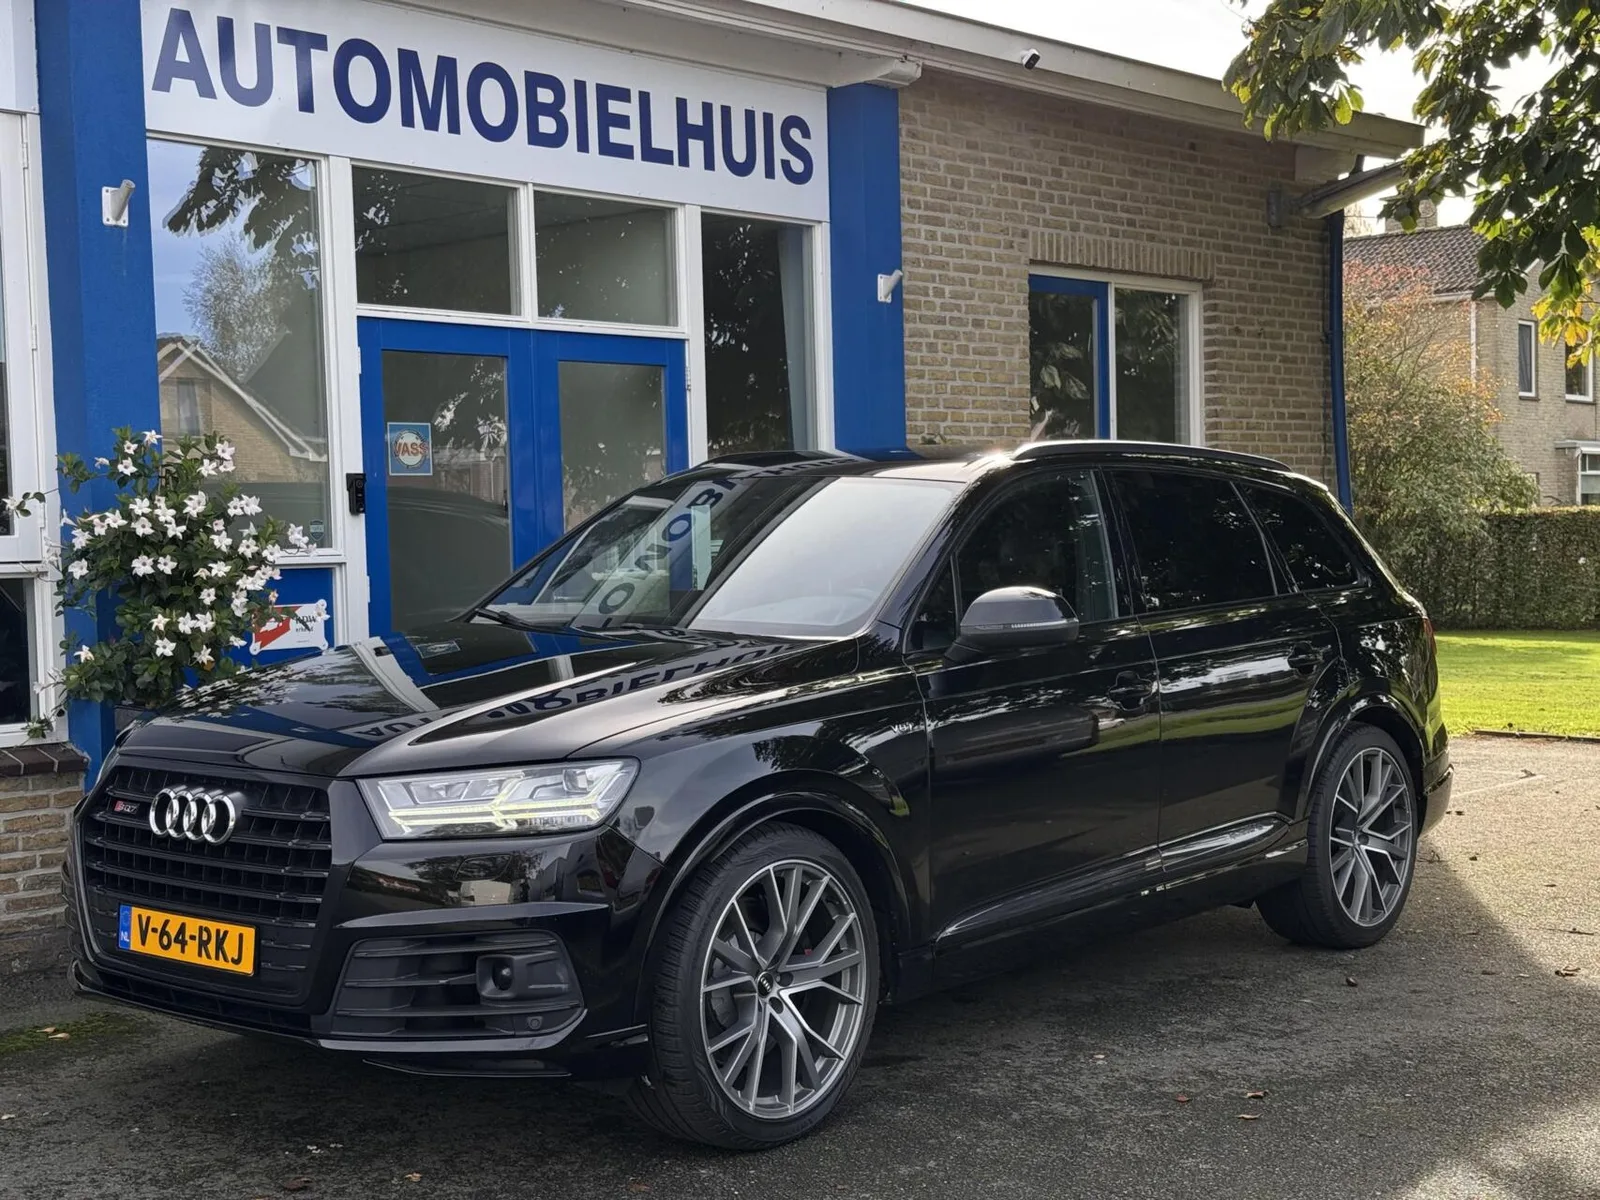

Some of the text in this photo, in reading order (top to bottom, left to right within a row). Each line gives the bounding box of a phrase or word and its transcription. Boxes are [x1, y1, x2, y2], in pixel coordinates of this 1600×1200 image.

[151, 7, 814, 185] AUTOMOBIELHUIS
[120, 931, 130, 942] NL
[137, 913, 244, 966] V-64-RKJ
